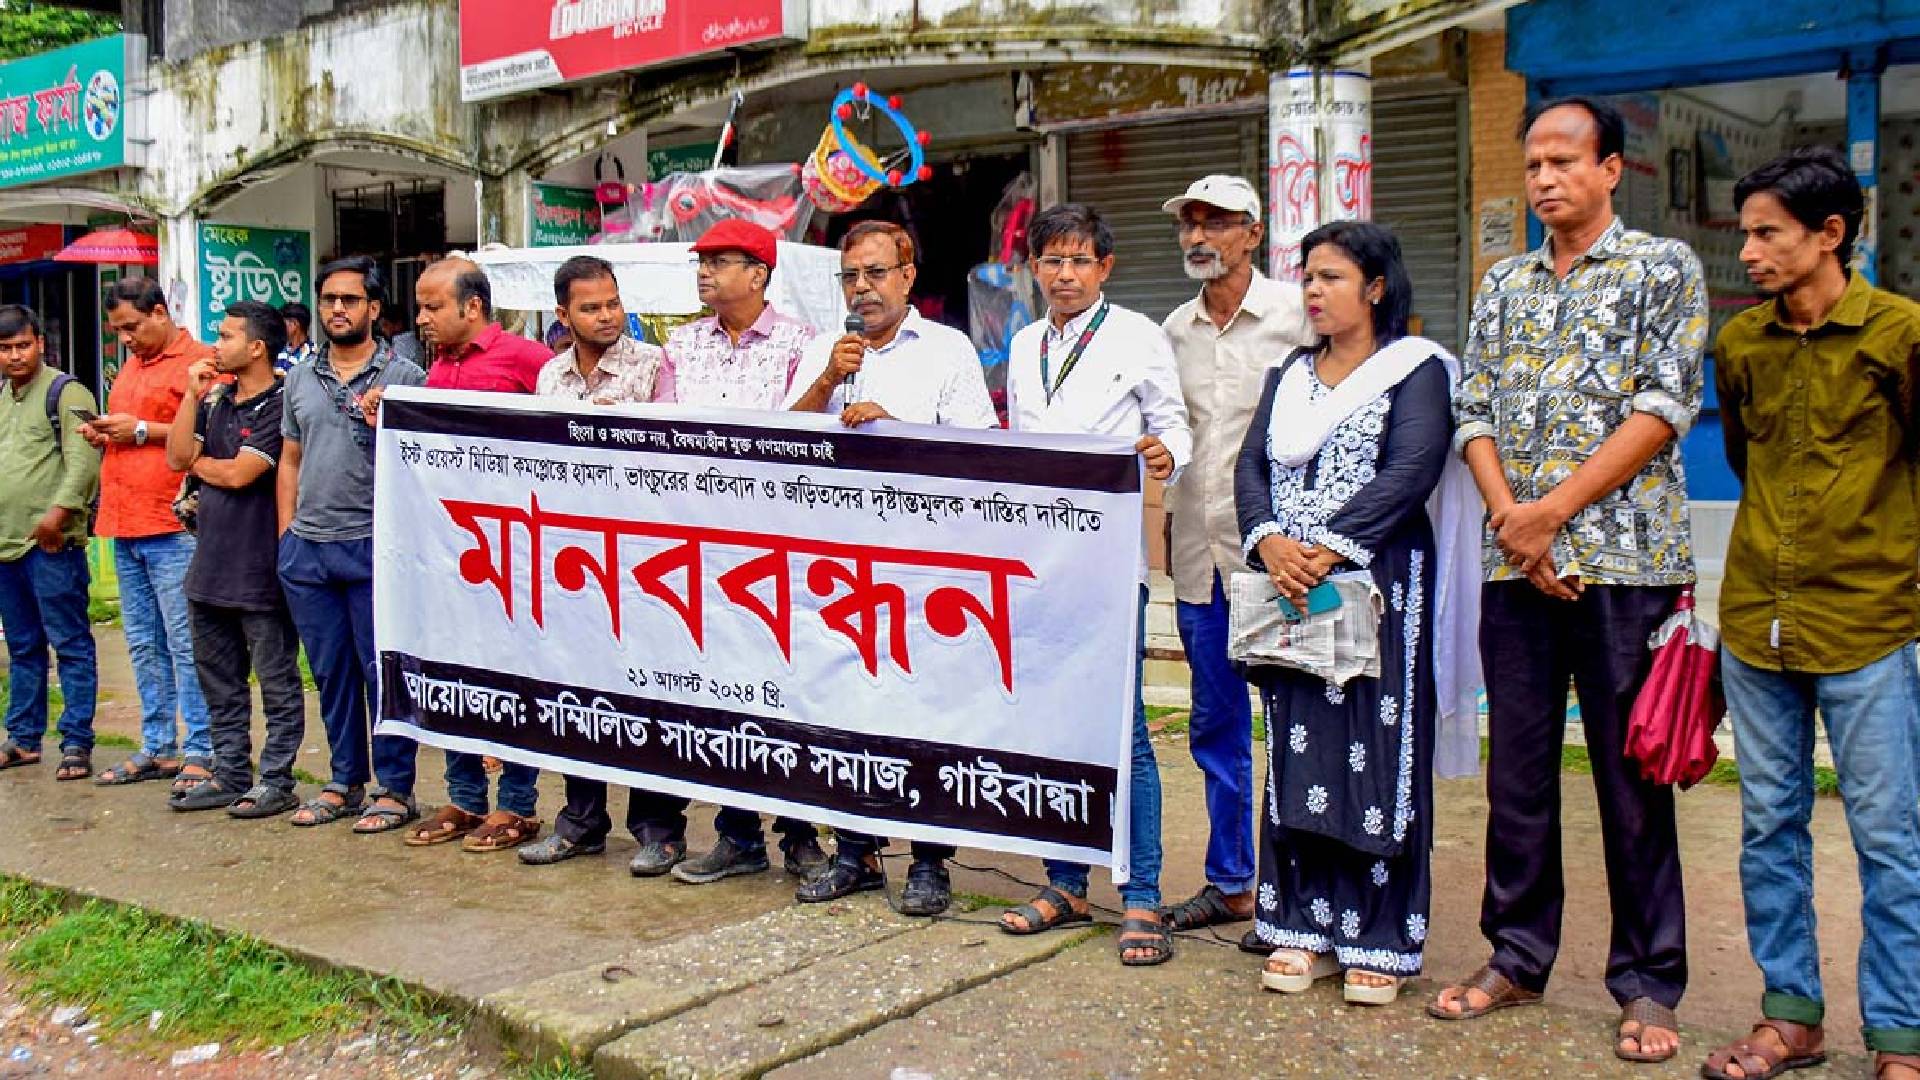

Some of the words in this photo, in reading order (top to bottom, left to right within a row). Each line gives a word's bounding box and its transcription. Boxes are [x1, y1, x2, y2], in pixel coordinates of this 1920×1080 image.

[425, 443, 465, 469] ওয়েস্ট
[468, 444, 509, 477] মিডিয়া
[571, 459, 620, 491] হামলা,
[694, 465, 757, 500] প্রতিবাদ
[761, 479, 777, 500] ও
[780, 474, 865, 510] জড়িতদের
[869, 482, 965, 526] দৃষ্টান্তমূলক
[969, 490, 1029, 528] শাস্তির
[1032, 497, 1104, 533] দাবীতে
[597, 427, 608, 442] ও
[609, 427, 646, 445] সংঘাত
[810, 438, 835, 463] চাই
[438, 491, 1037, 696] মানববন্ধন
[626, 667, 648, 688] ২১
[652, 669, 703, 694] আগস্ট
[708, 678, 755, 705] ২০২৪
[533, 690, 651, 749] সম্মিলিত
[655, 717, 801, 779] সাংবাদিক
[807, 744, 921, 809] সমাজ,
[938, 755, 1096, 825] গাইবান্ধা
